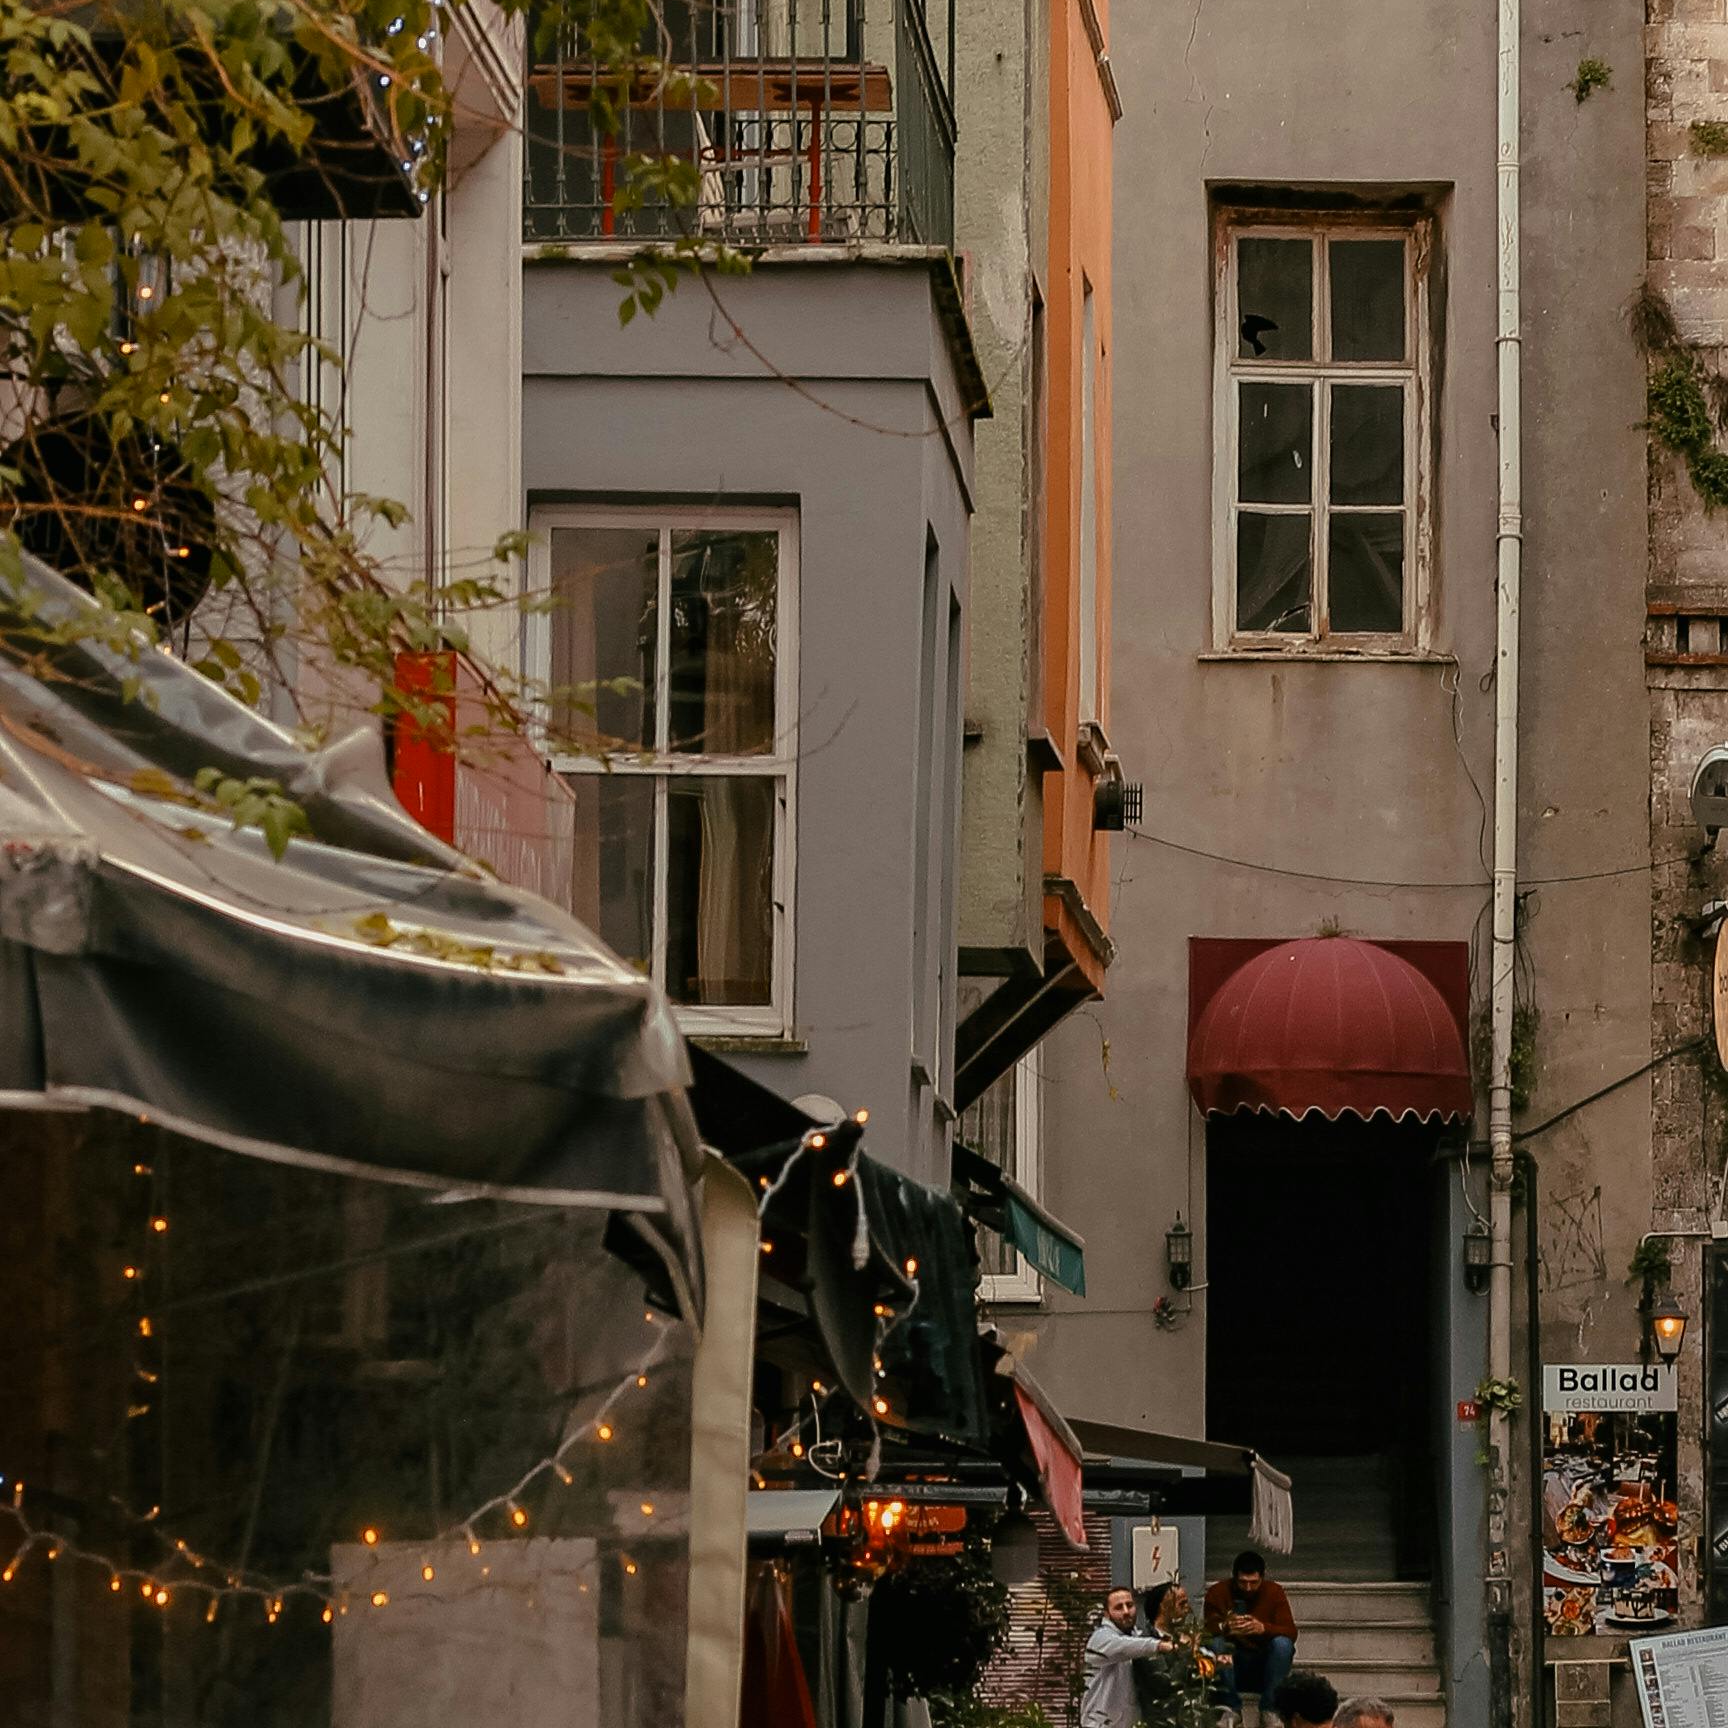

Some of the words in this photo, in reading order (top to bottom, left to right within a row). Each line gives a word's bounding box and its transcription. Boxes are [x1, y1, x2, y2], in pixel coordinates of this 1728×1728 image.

[1559, 1367, 1659, 1391] Ballad
[1565, 1396, 1653, 1409] restaurant
[1463, 1404, 1475, 1416] 74
